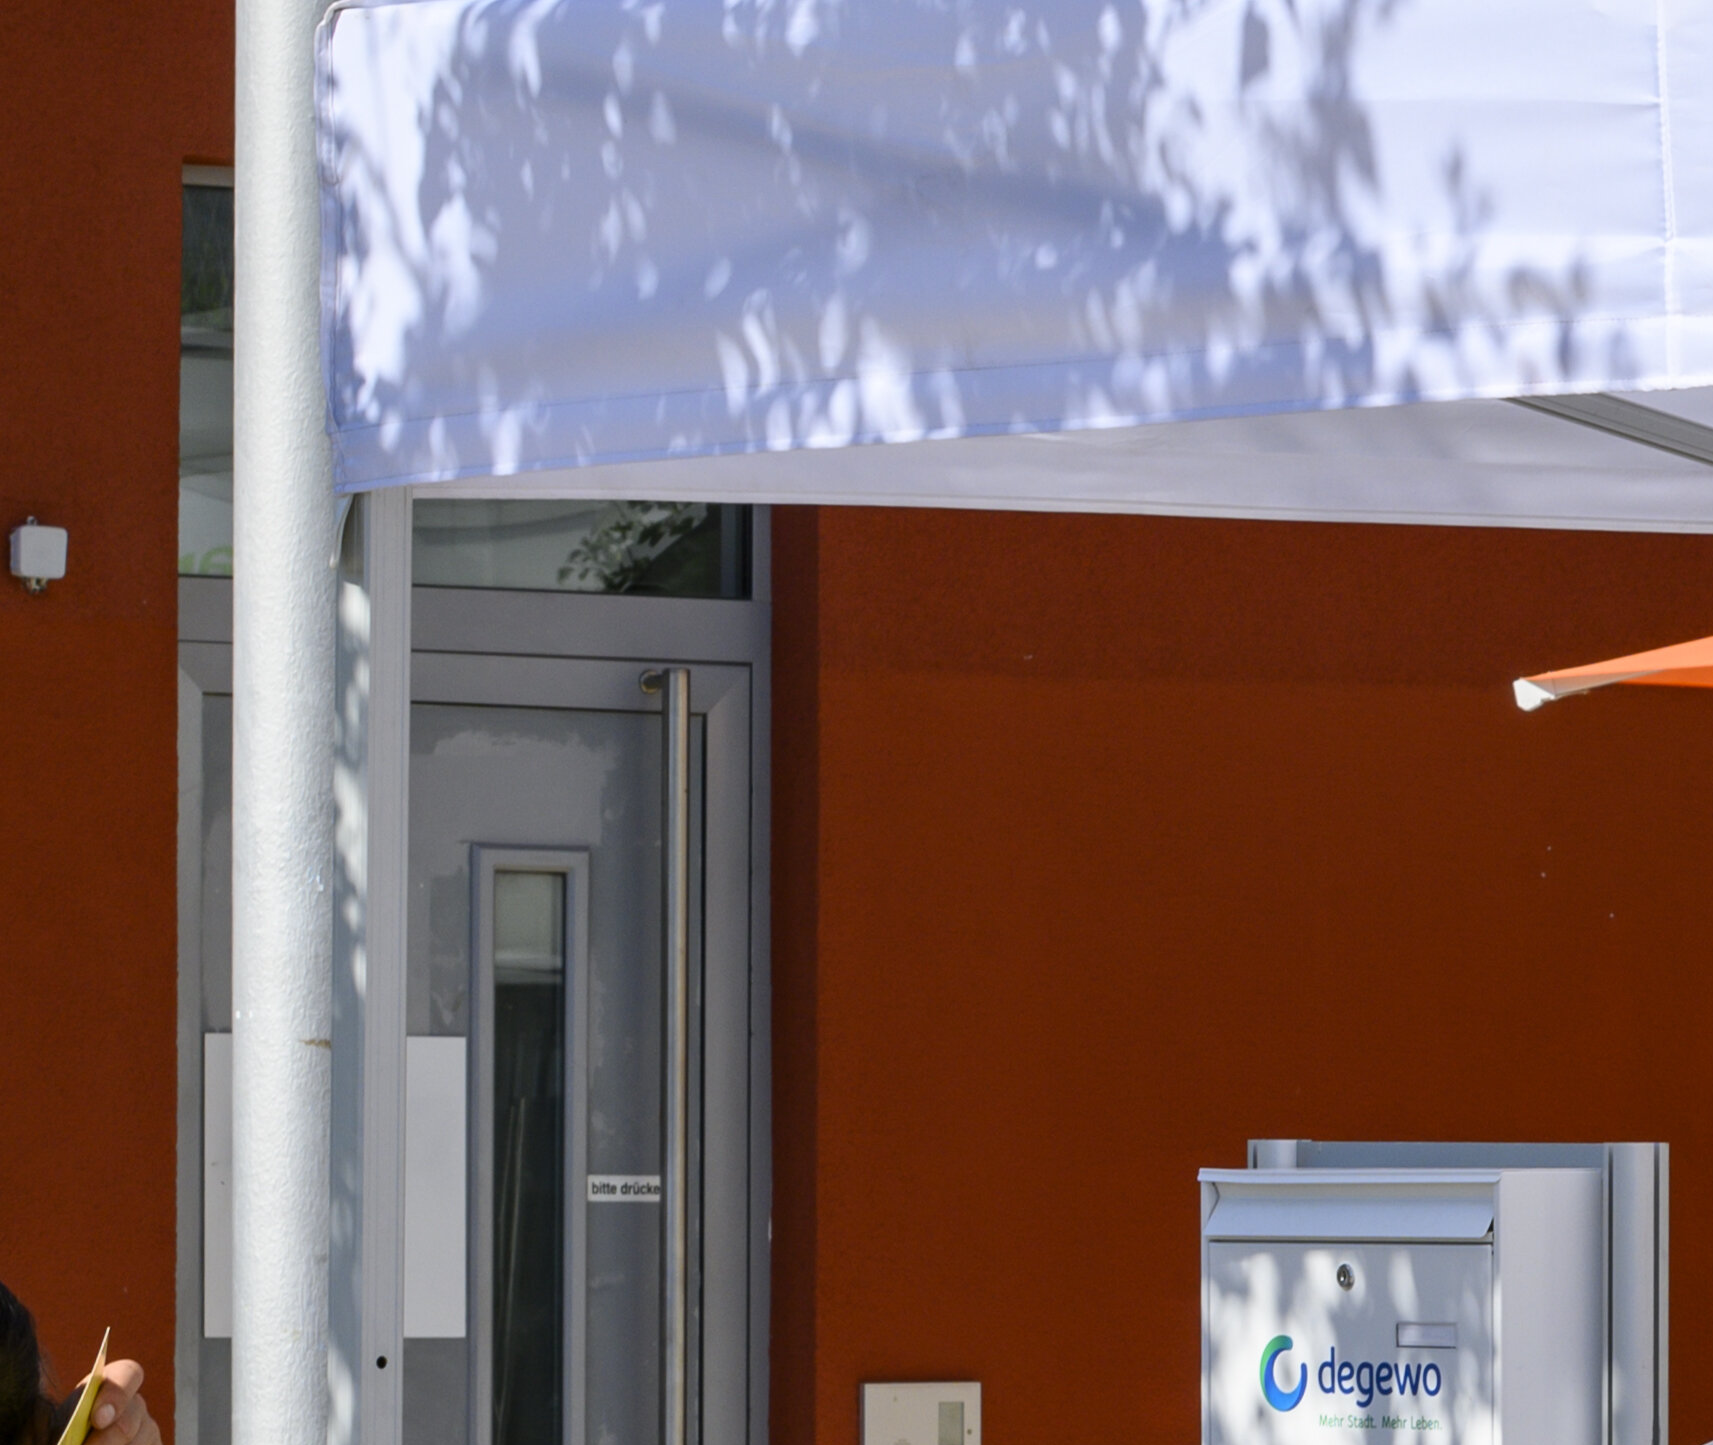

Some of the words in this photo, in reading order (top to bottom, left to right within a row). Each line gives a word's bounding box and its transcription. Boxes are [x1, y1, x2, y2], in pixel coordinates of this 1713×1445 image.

[591, 1181, 618, 1196] bitte
[620, 1181, 661, 1196] drücke
[1317, 1345, 1442, 1409] degewo
[1318, 1414, 1345, 1428] Mehr
[1347, 1413, 1377, 1430] Stadt.
[1381, 1414, 1408, 1430] Mehr
[1409, 1415, 1443, 1431] Leben.
